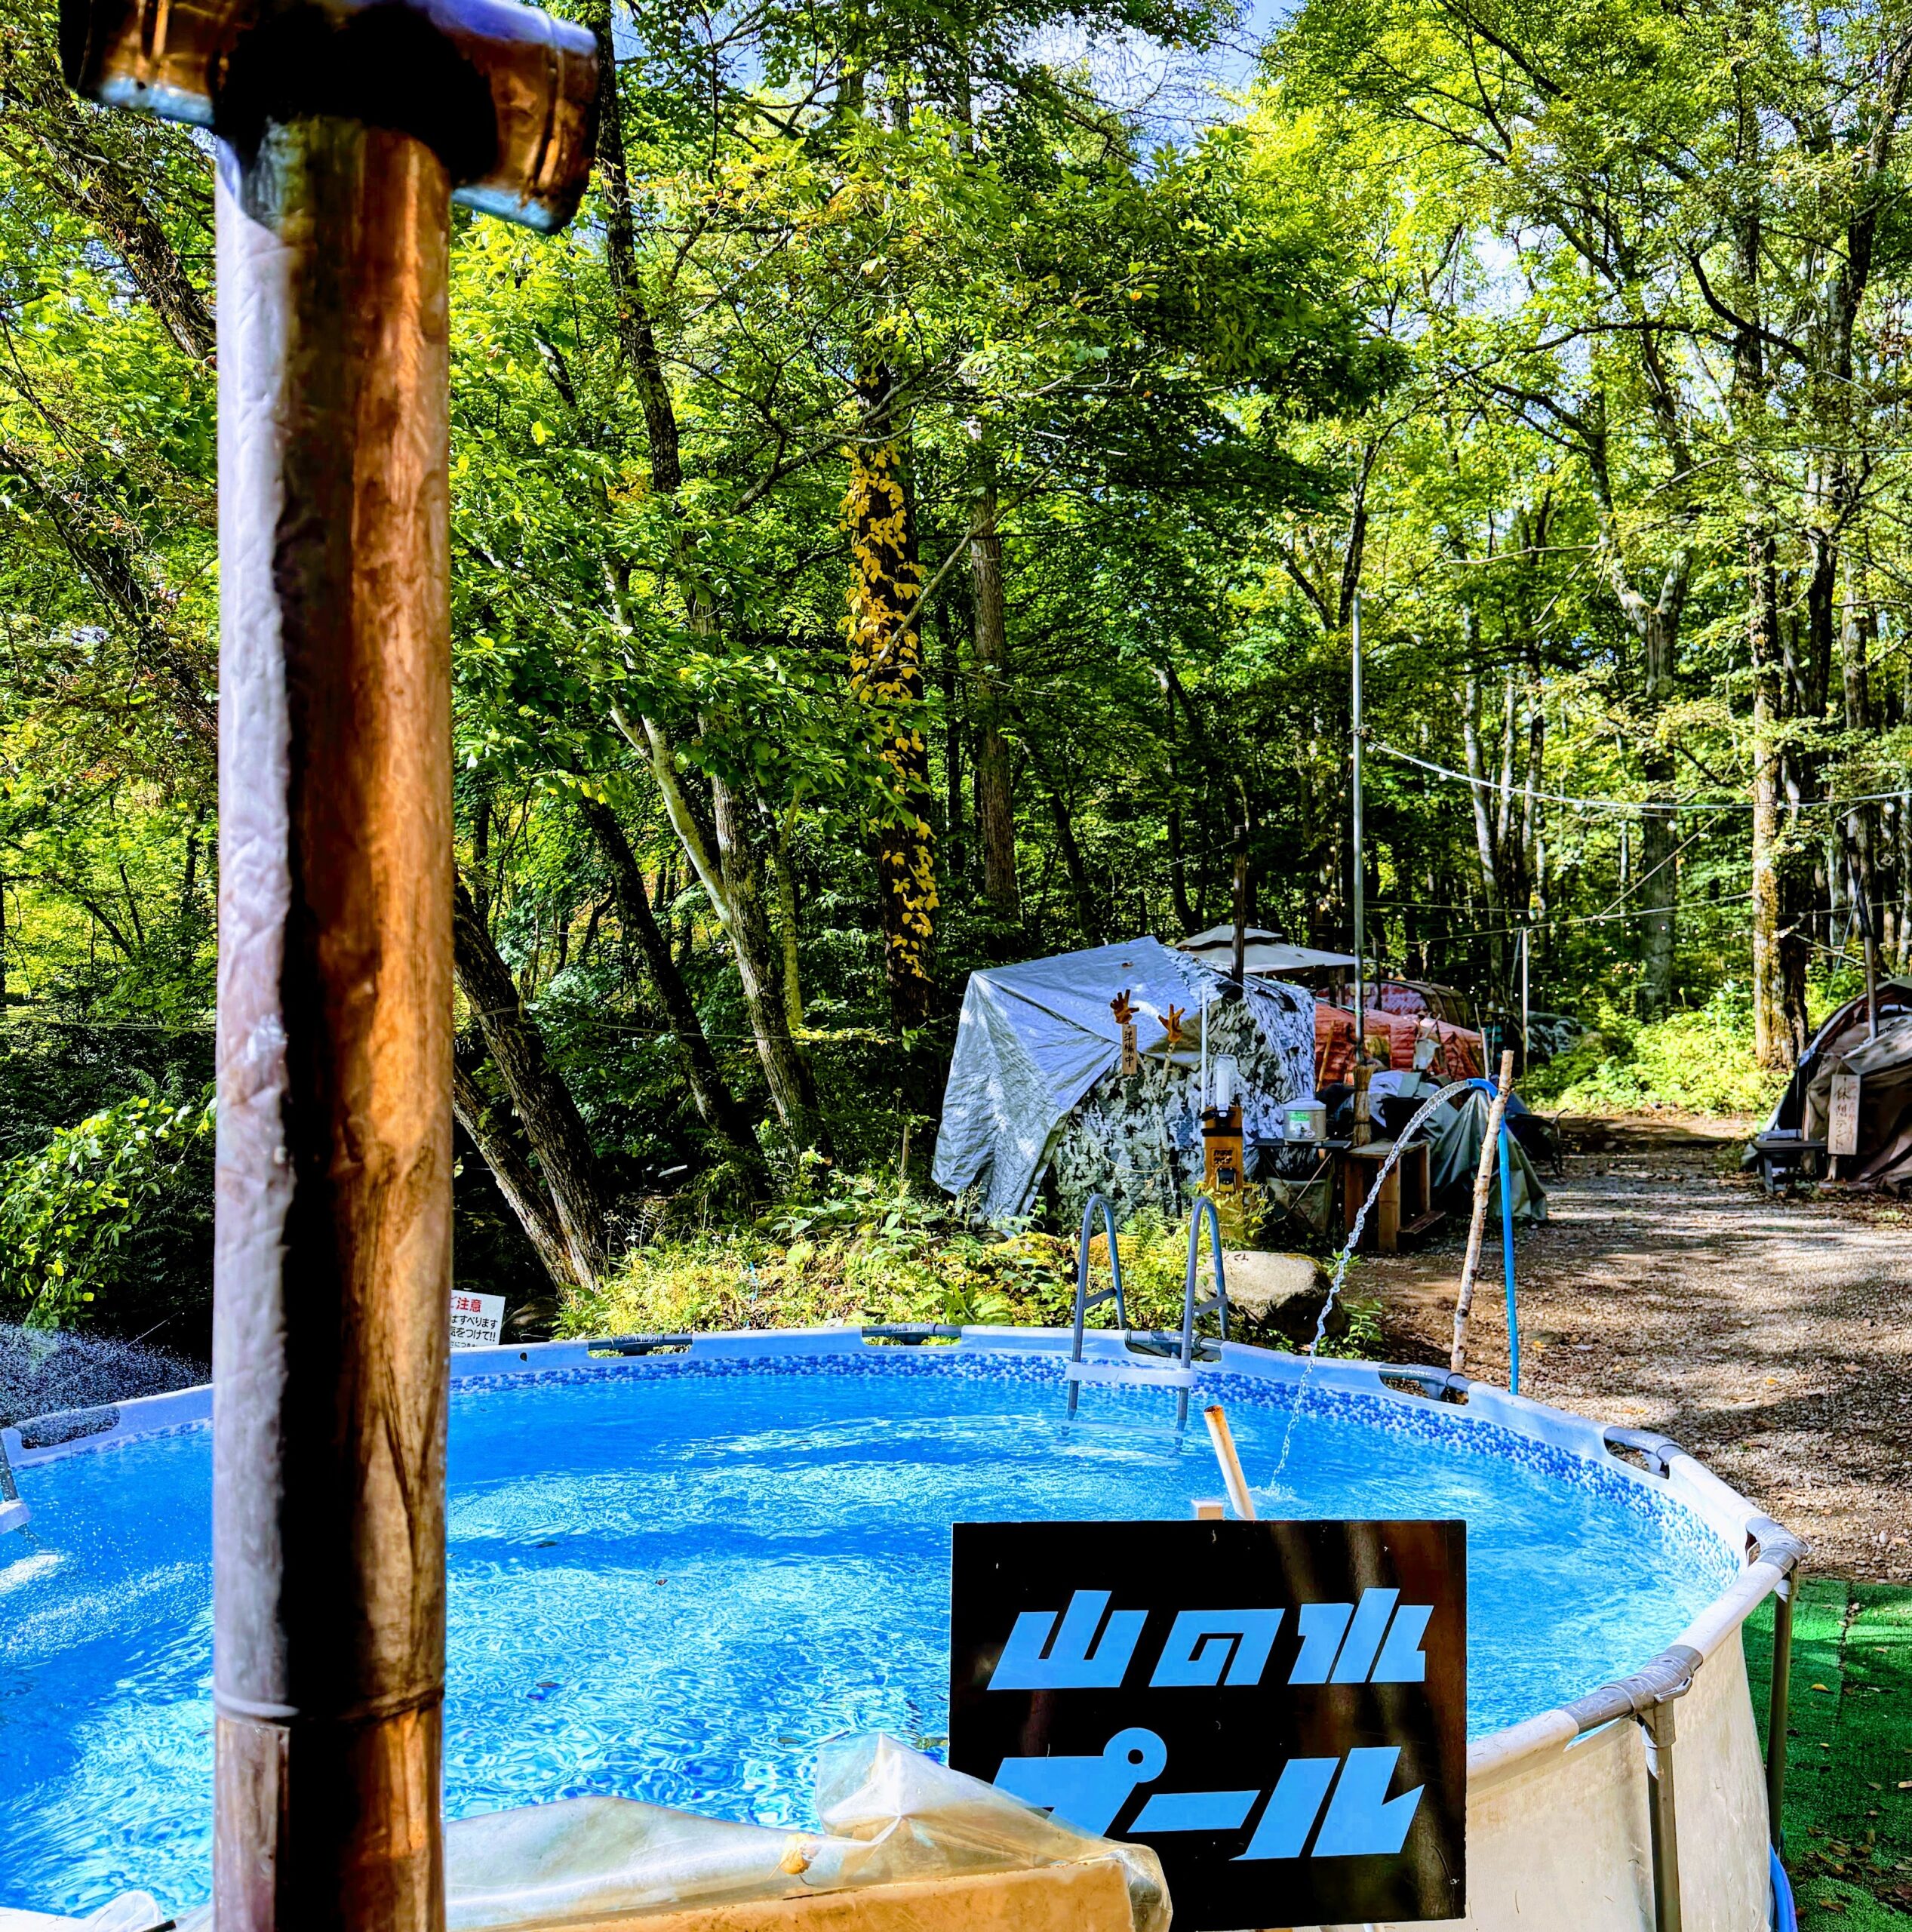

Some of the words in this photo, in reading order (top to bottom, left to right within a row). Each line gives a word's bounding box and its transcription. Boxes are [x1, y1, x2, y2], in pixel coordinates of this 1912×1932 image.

[1124, 1030, 1134, 1067] 準備中
[987, 1587, 1434, 1690] 山の水
[992, 1727, 1425, 1861] プール
